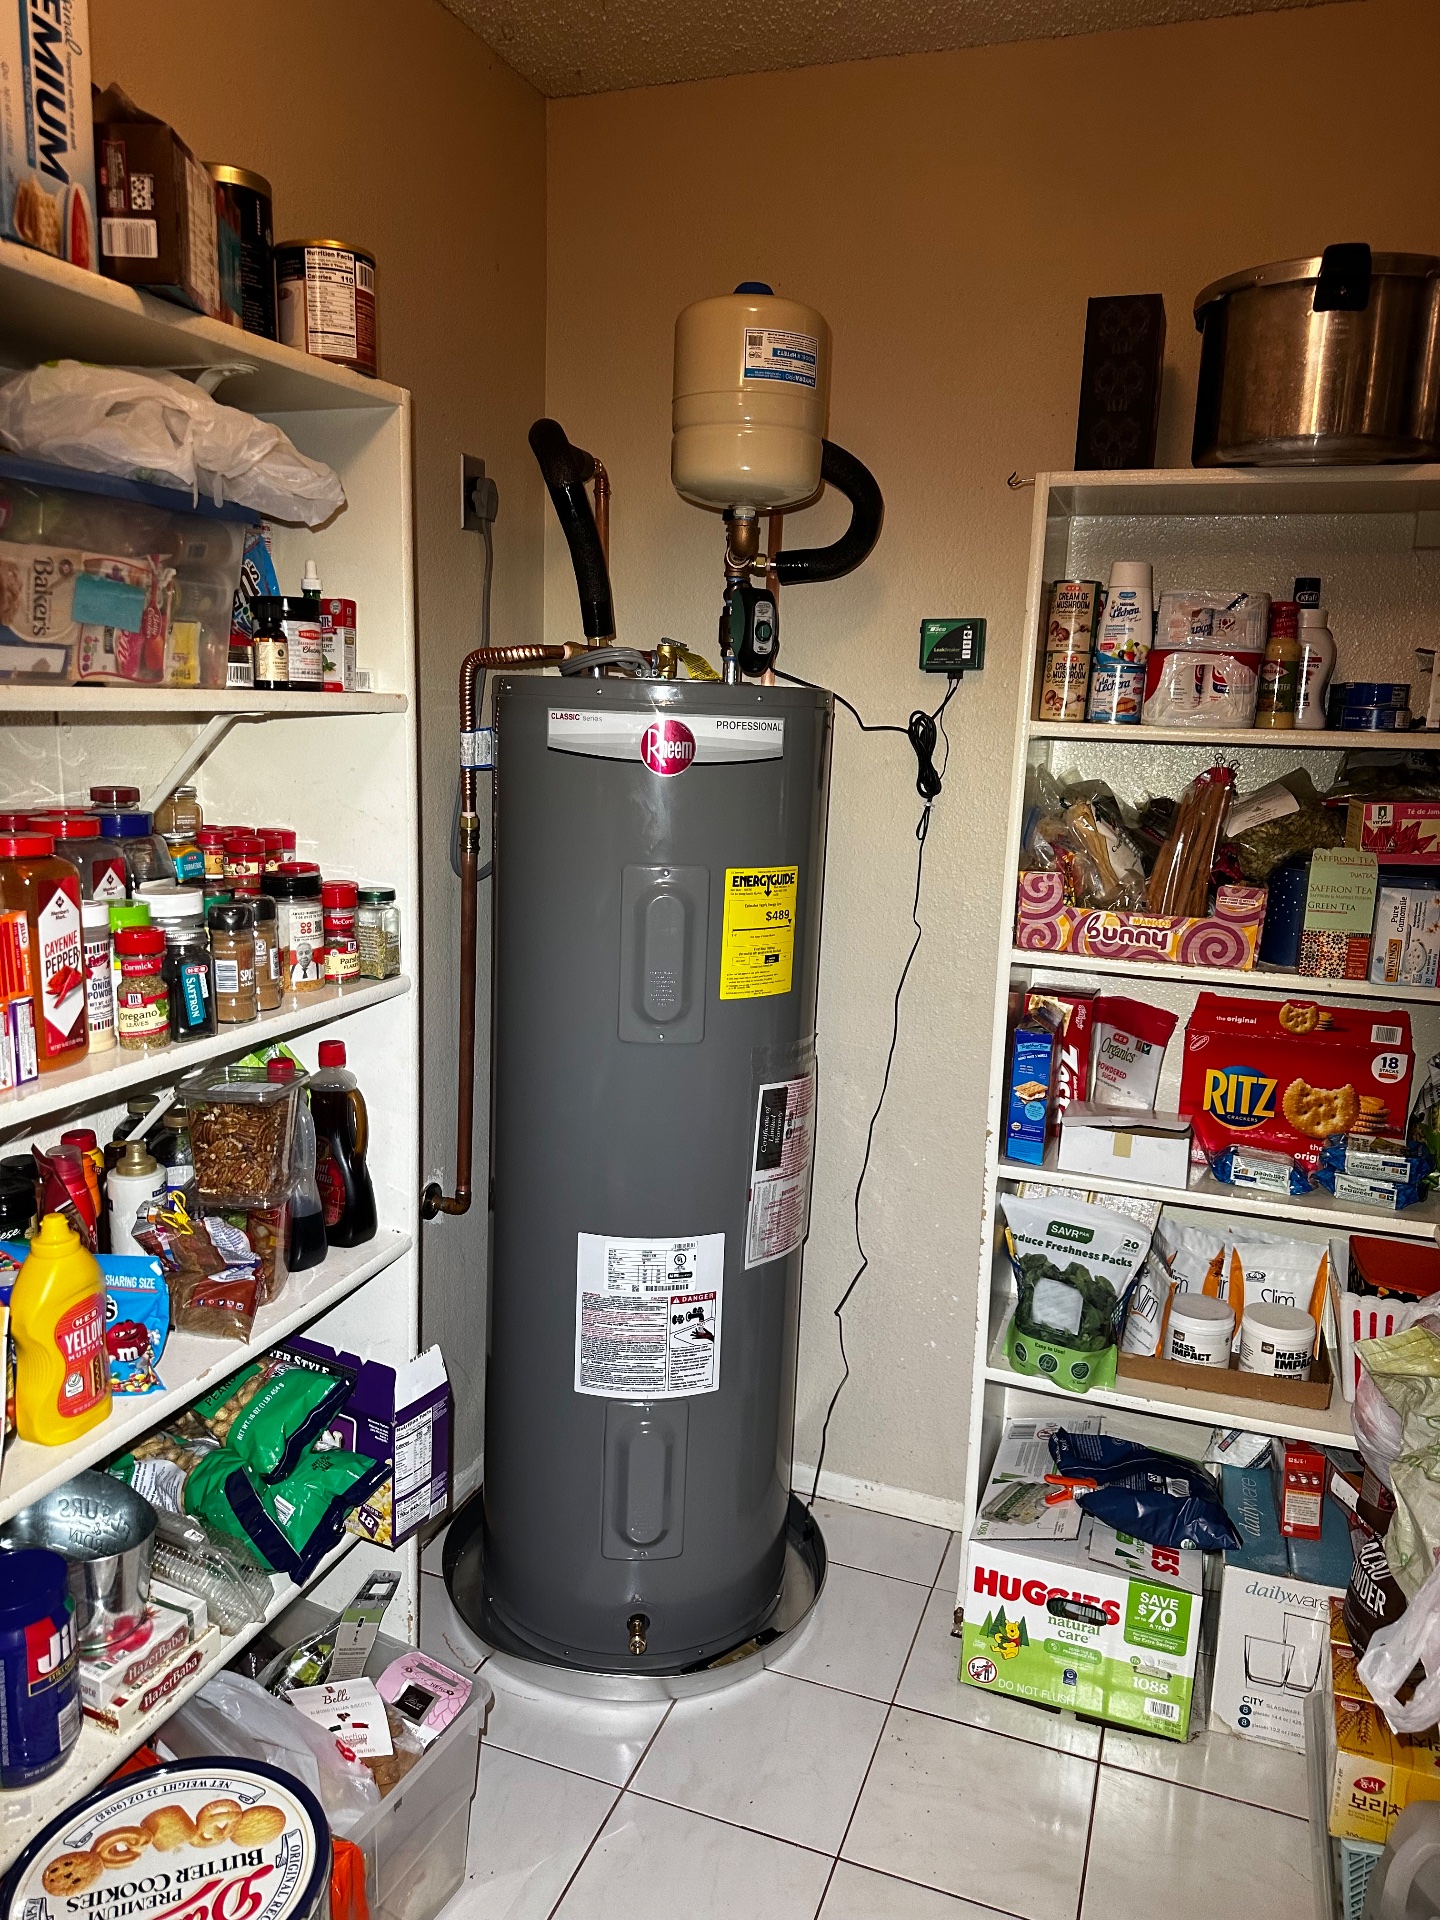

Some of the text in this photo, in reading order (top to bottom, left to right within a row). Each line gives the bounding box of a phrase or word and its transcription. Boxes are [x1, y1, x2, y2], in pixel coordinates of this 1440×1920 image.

[306, 249, 354, 262] Nutrition Facts
[307, 273, 354, 285] Calories 110
[33, 557, 54, 636] Baker's
[1058, 592, 1089, 600] CREAM OF
[1056, 600, 1090, 609] MUSHROOM
[1055, 663, 1078, 671] CREM
[1052, 671, 1087, 679] MUSROOM
[550, 712, 580, 721] CLASSIC
[716, 720, 782, 732] PROFESSIONAL
[647, 729, 693, 767] Rheem
[1313, 853, 1377, 865] SAFFRON TEA
[732, 872, 795, 888] ENERGYGUIDE
[1310, 883, 1373, 895] SAFFRON TEA
[1308, 901, 1356, 911] GREEN TEA
[765, 909, 790, 921] $489
[1391, 905, 1399, 924] Pure
[1397, 896, 1408, 932] Camomile
[44, 929, 78, 958] CAYENNE
[45, 946, 80, 977] PEPPER
[1386, 942, 1398, 979] TWININGS
[92, 979, 111, 992] ONION
[186, 977, 201, 1018] SAFFRON
[119, 1009, 158, 1022] Oregano
[1226, 1015, 1257, 1024] original
[126, 1020, 150, 1028] LEAVES
[1101, 1036, 1135, 1063] Organics
[1381, 1057, 1399, 1069] 18
[1102, 1072, 1117, 1083] SUGAR
[1203, 1068, 1278, 1118] RITZ
[1227, 1114, 1258, 1122] CRACKERS
[761, 1111, 771, 1153] Certificate
[1351, 1162, 1386, 1172] Seaweed
[1254, 1169, 1285, 1181] Seaweed
[1339, 1184, 1373, 1197] Seaweed
[1050, 1225, 1079, 1238] SAVR
[1123, 1239, 1140, 1250] 20
[1045, 1240, 1100, 1261] Freshness
[1101, 1253, 1133, 1268] Packs
[106, 1274, 156, 1289] SHARING SIZE
[682, 1292, 715, 1303] DANGER
[1133, 1283, 1159, 1324] Slim
[1261, 1289, 1296, 1308] Slim
[75, 1309, 97, 1327] H-E-B
[1034, 1342, 1047, 1351] Easy
[1054, 1347, 1066, 1355] Use!
[1172, 1339, 1196, 1353] MASS
[1171, 1348, 1212, 1362] IMPACT
[1275, 1350, 1308, 1360] MASS
[294, 1354, 330, 1375] STYLE
[236, 1429, 245, 1441] NET
[242, 1418, 252, 1431] WT.
[252, 1405, 262, 1415] OZ
[270, 1385, 281, 1397] 454
[396, 1416, 419, 1433] Nutrition
[419, 1410, 432, 1420] Facts
[1237, 1477, 1262, 1537] dailyware
[359, 1511, 375, 1529] 18
[1140, 1591, 1179, 1610] SAVE
[1245, 1581, 1329, 1611] dailyware
[1138, 1603, 1177, 1628] $70
[1048, 1614, 1101, 1637] natural
[1057, 1629, 1089, 1643] care
[128, 1632, 184, 1681] HazerBaba
[144, 1656, 198, 1708] HazerBaba
[1132, 1676, 1169, 1695] 1088
[322, 1688, 351, 1705] Belli
[998, 1679, 1075, 1706] DO NOT FLUSH
[331, 1704, 350, 1712] ITALIAN
[1242, 1695, 1301, 1716] CITY GLASSWARE
[1252, 1710, 1270, 1719] glasses
[1252, 1723, 1269, 1731] glasses
[1360, 1778, 1379, 1792] 동서
[95, 1780, 232, 1823] NET WEIGHT 32 OZ (908g)
[66, 1847, 264, 1914] BUTTER COOKIES
[277, 1844, 301, 1902] ORIGINAL
[87, 1888, 183, 1920] PREMIUM
